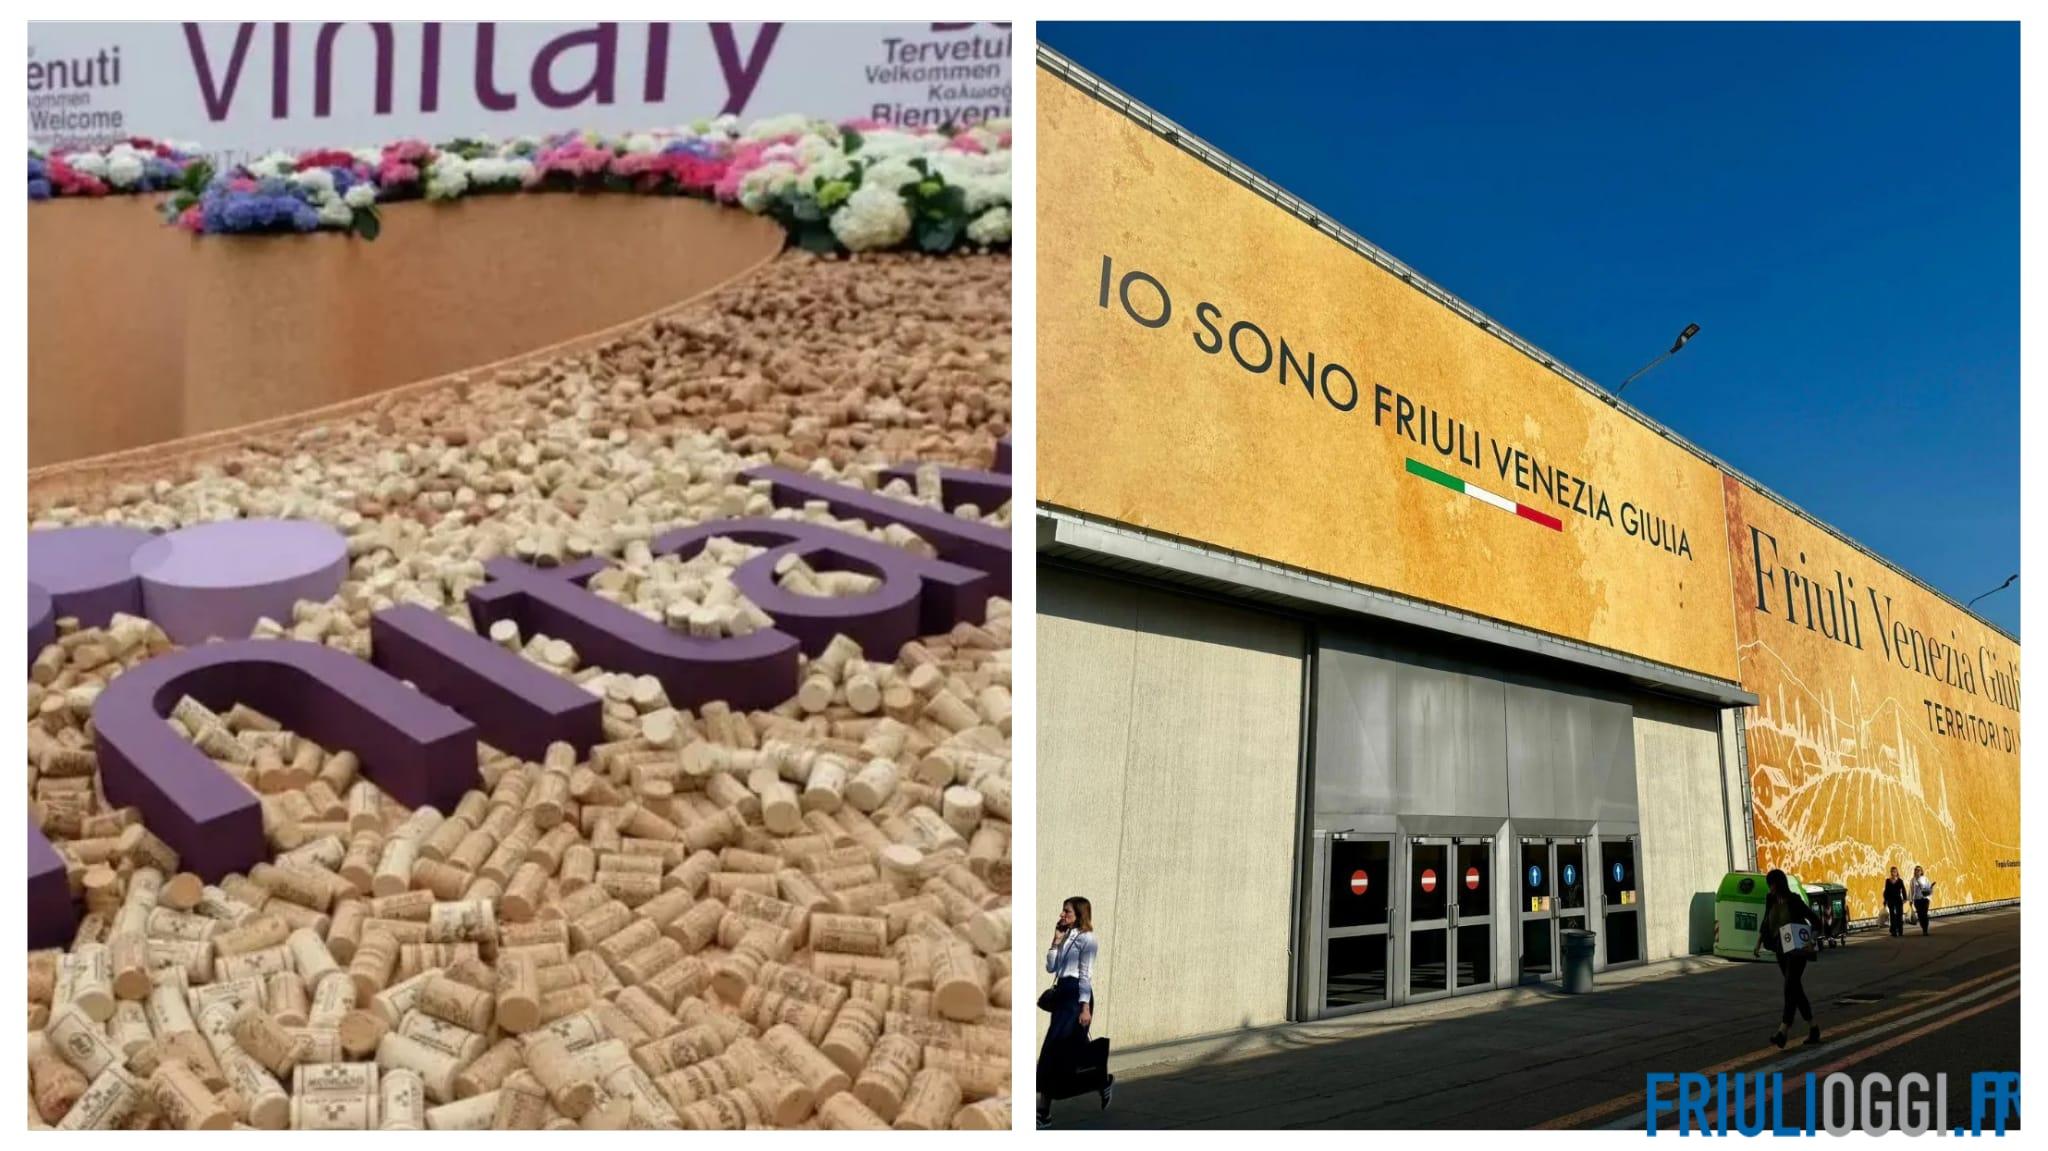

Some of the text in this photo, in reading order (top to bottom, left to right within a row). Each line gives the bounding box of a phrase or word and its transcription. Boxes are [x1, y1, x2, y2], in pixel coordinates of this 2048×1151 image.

[28, 46, 121, 90] enuti
[864, 64, 1001, 85] Velkommen
[31, 109, 122, 130] Welcome
[1099, 254, 1693, 561] IO SONO FRIULI VENEZIA GIULIA
[1748, 525, 1864, 651] Friuli
[1867, 586, 1976, 695] Venezia
[1923, 699, 2002, 751] TERRITORI
[2003, 726, 2017, 755] DI
